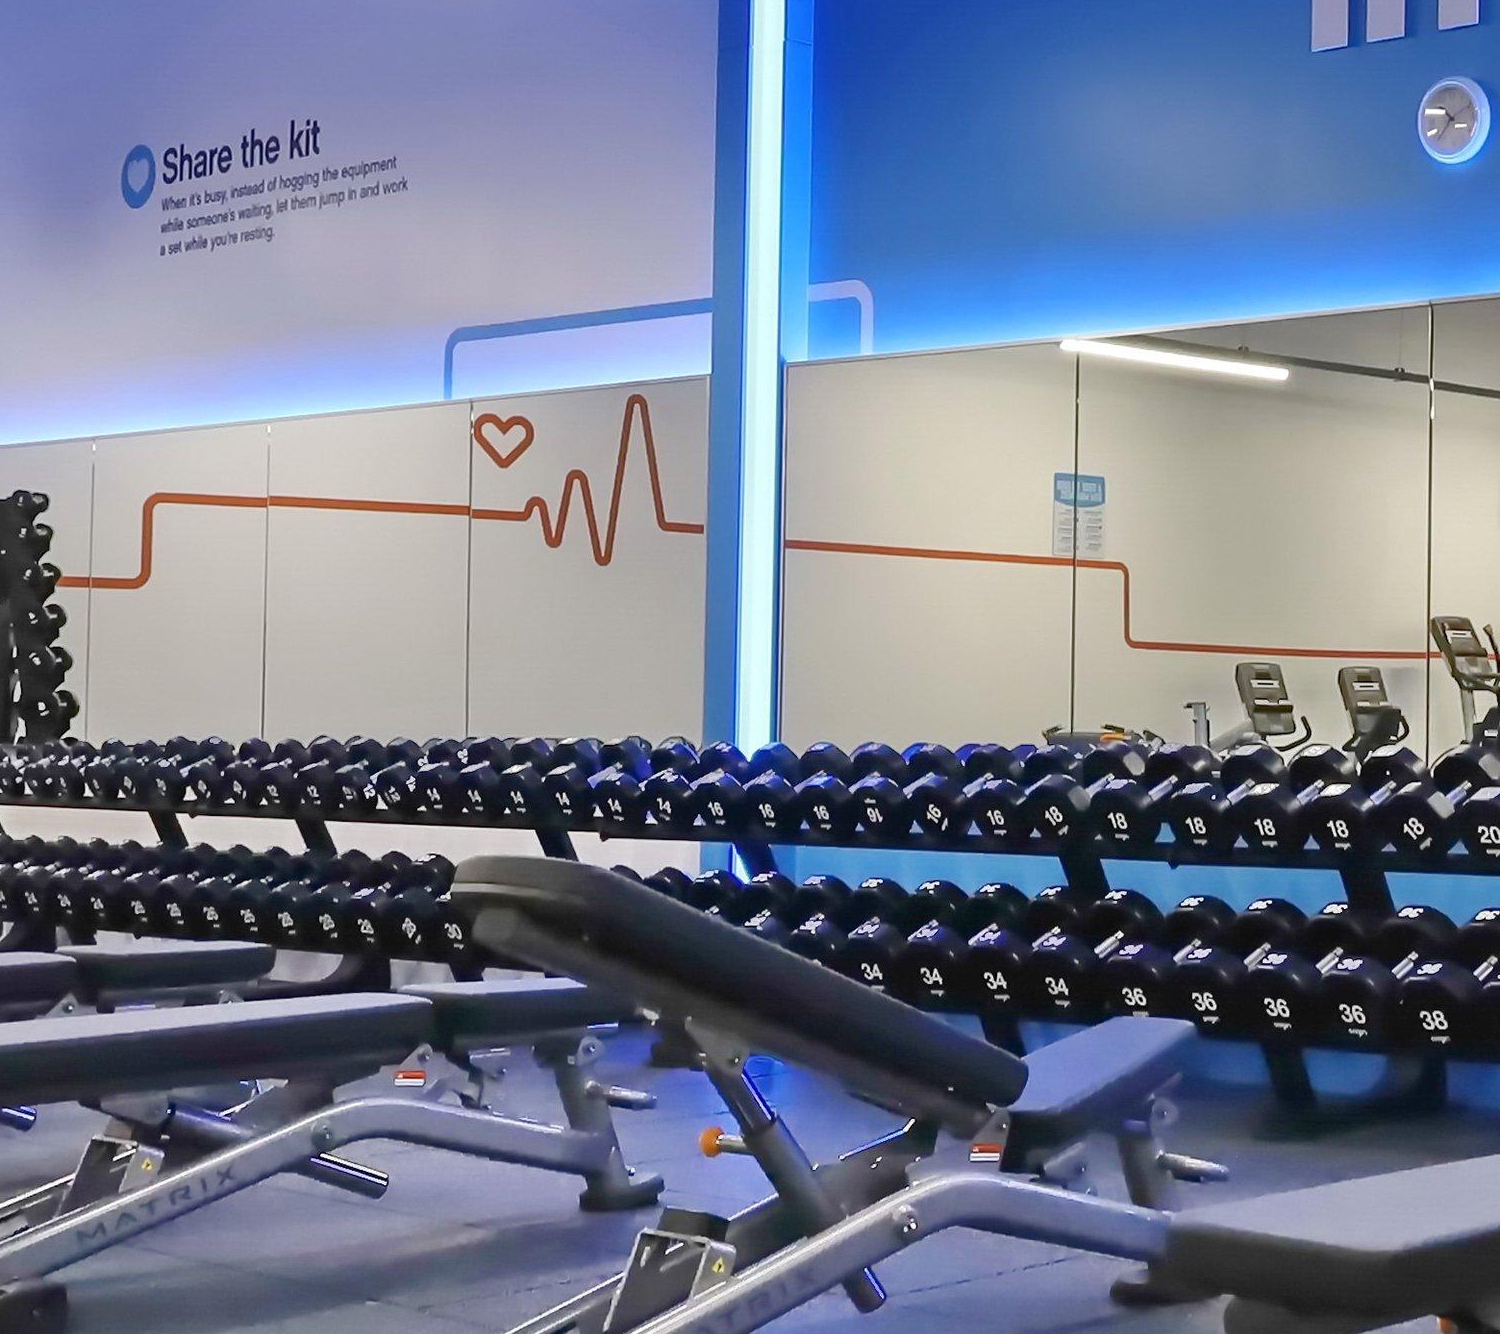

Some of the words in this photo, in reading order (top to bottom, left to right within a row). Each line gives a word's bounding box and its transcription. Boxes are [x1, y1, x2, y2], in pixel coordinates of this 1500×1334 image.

[162, 144, 233, 185] Share
[240, 129, 281, 168] the
[289, 119, 321, 160] kit
[161, 195, 187, 212] When
[204, 190, 228, 205] busy,
[230, 178, 265, 198] instead
[267, 176, 277, 192] of
[279, 171, 320, 192] hogging
[322, 167, 339, 182] the
[341, 155, 397, 180] equipment
[160, 217, 184, 233] while
[276, 197, 288, 214] let
[290, 194, 317, 210] them
[318, 191, 345, 210] jump
[347, 186, 357, 201] in
[360, 181, 380, 199] and
[382, 175, 409, 194] work
[168, 240, 183, 255] set
[184, 234, 208, 252] while
[240, 226, 276, 243] resting.
[708, 802, 723, 816] 16
[759, 804, 774, 818] 16
[813, 806, 829, 820] 16
[987, 810, 1004, 825] 16
[1045, 806, 1063, 825] 18
[1108, 812, 1127, 829] 18
[1186, 817, 1206, 834] 18
[1254, 819, 1275, 835] 18
[1327, 820, 1348, 837] 18
[1404, 818, 1424, 840] 18
[861, 963, 883, 980] 34
[921, 968, 942, 984] 34
[984, 972, 1007, 989] 34
[1045, 977, 1068, 995] 34
[1122, 988, 1146, 1006] 36
[1192, 992, 1217, 1011] 36
[1264, 998, 1289, 1017] 36
[1339, 1004, 1366, 1024] 36
[1420, 1011, 1448, 1030] 38
[76, 1167, 238, 1245] MATRIX
